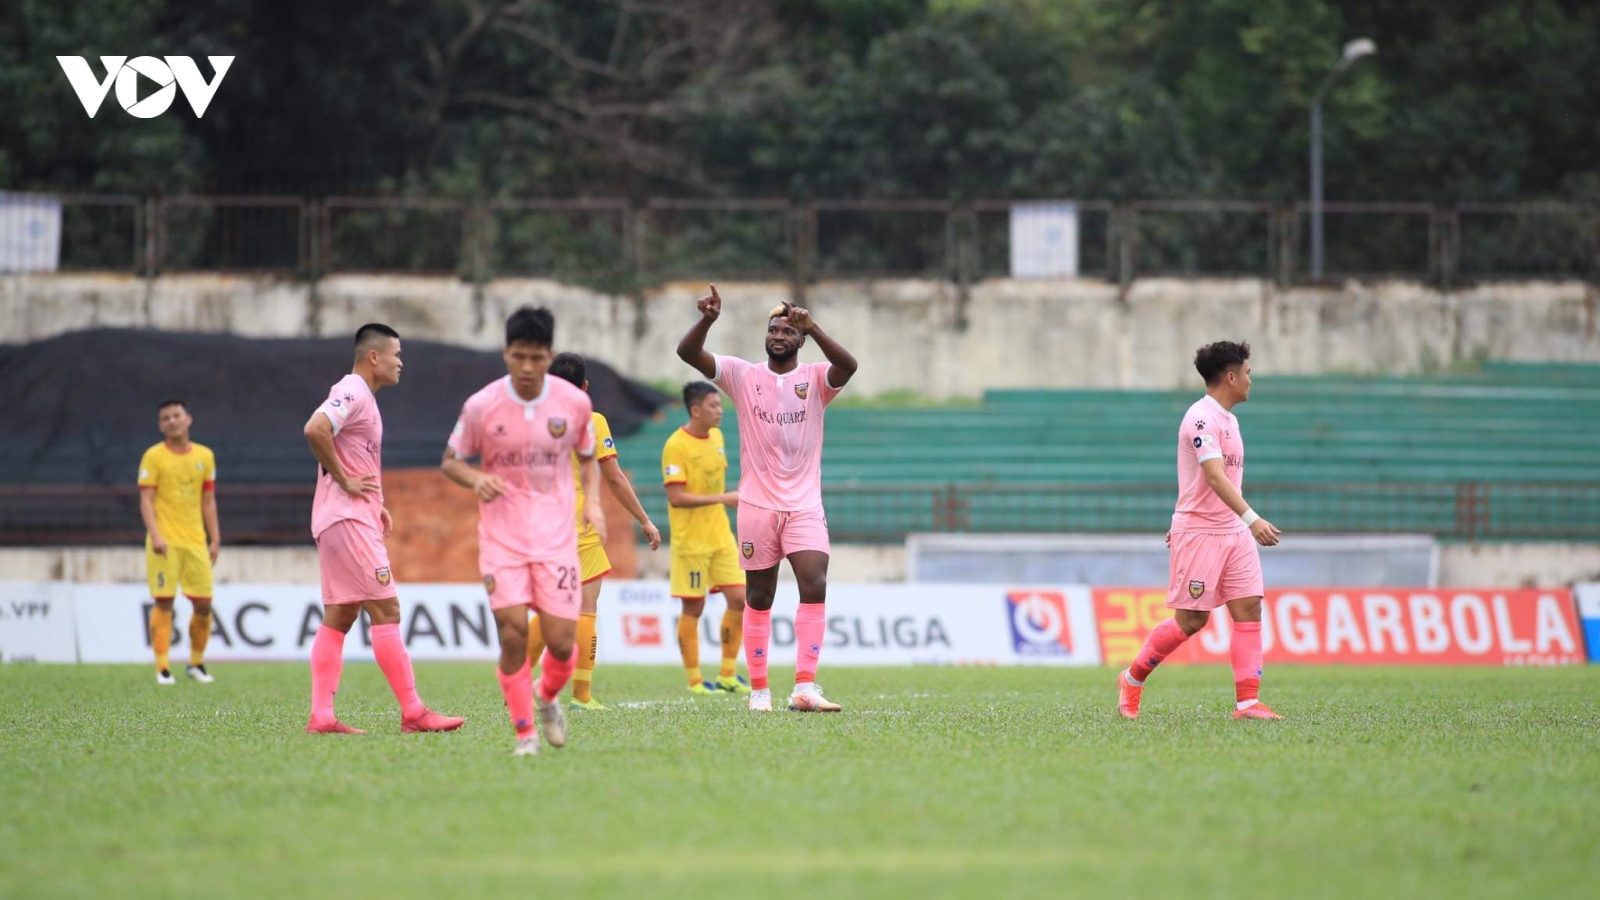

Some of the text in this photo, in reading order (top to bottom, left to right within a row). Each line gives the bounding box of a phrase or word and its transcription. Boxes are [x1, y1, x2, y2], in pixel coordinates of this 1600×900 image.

[776, 404, 806, 426] QUART
[157, 572, 165, 588] 5
[557, 566, 578, 590] 28
[689, 571, 701, 589] 11
[0, 601, 51, 619] .VPF
[675, 616, 950, 648] UDSLIGA
